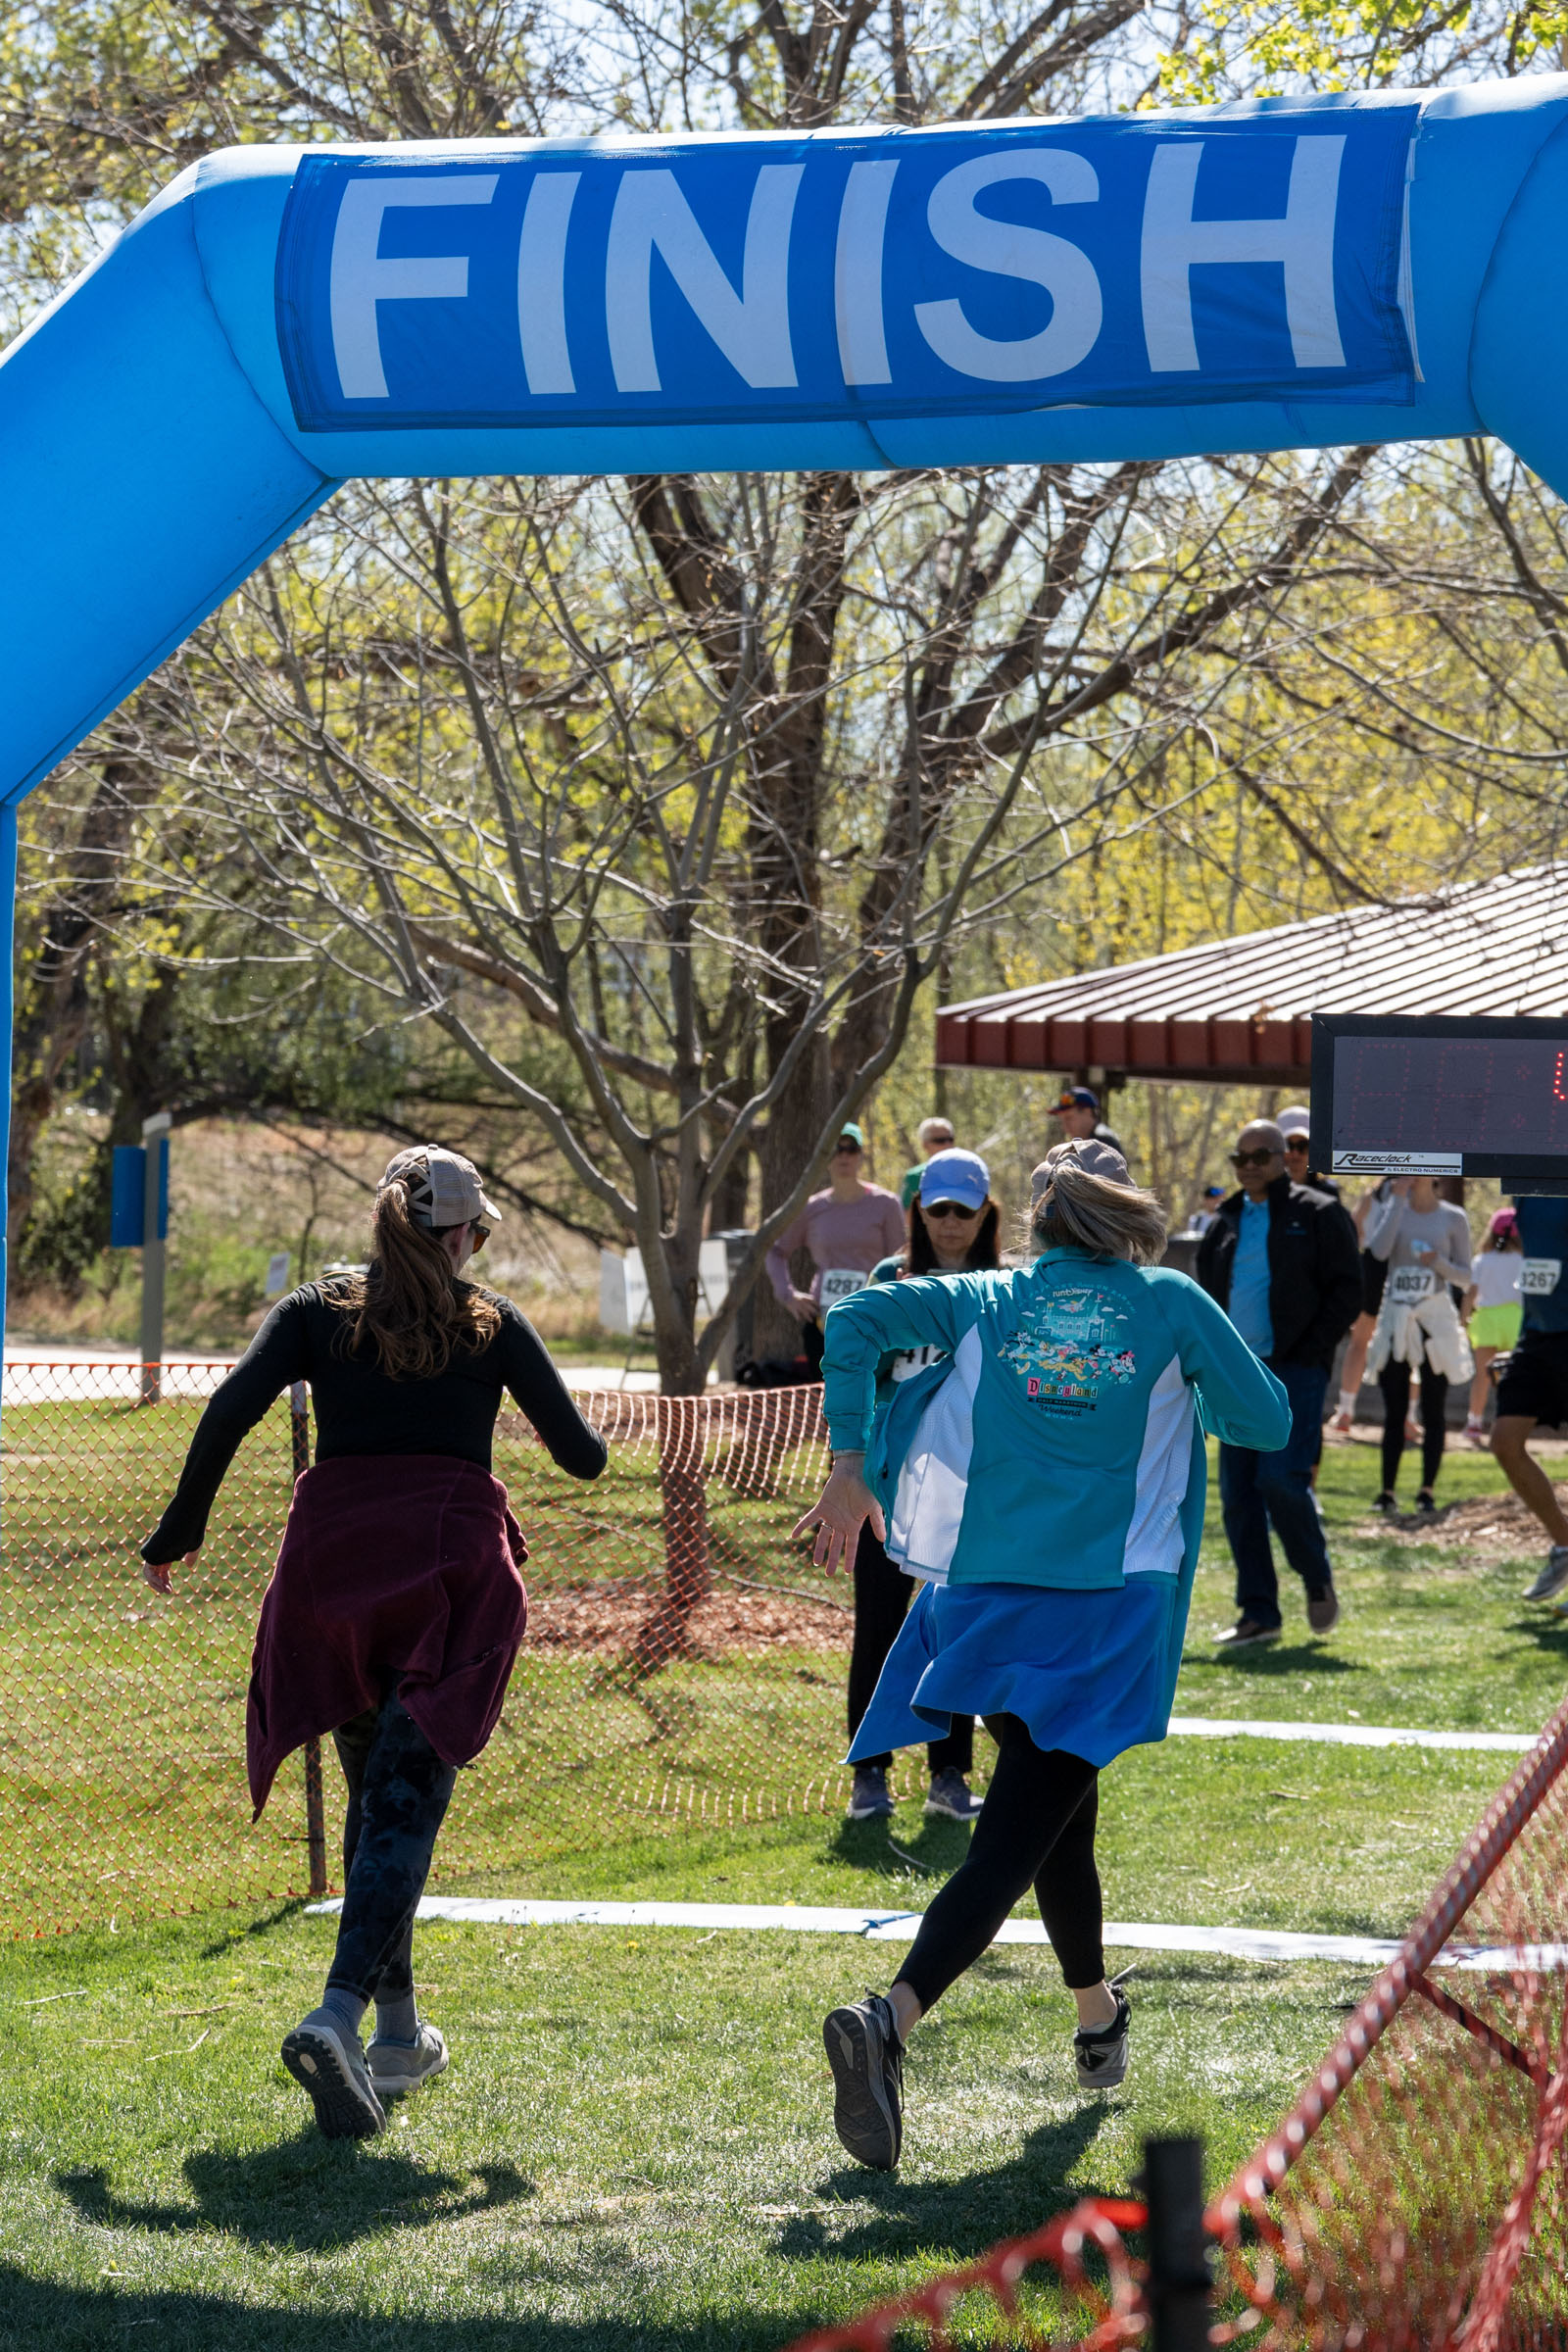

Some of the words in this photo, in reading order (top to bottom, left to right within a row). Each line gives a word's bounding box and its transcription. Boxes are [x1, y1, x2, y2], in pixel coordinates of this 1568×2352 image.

[330, 134, 1348, 398] FINISH
[1334, 1152, 1412, 1165] Raceclock
[1027, 1378, 1098, 1397] Disneyland
[1038, 1404, 1083, 1417] Weekend
